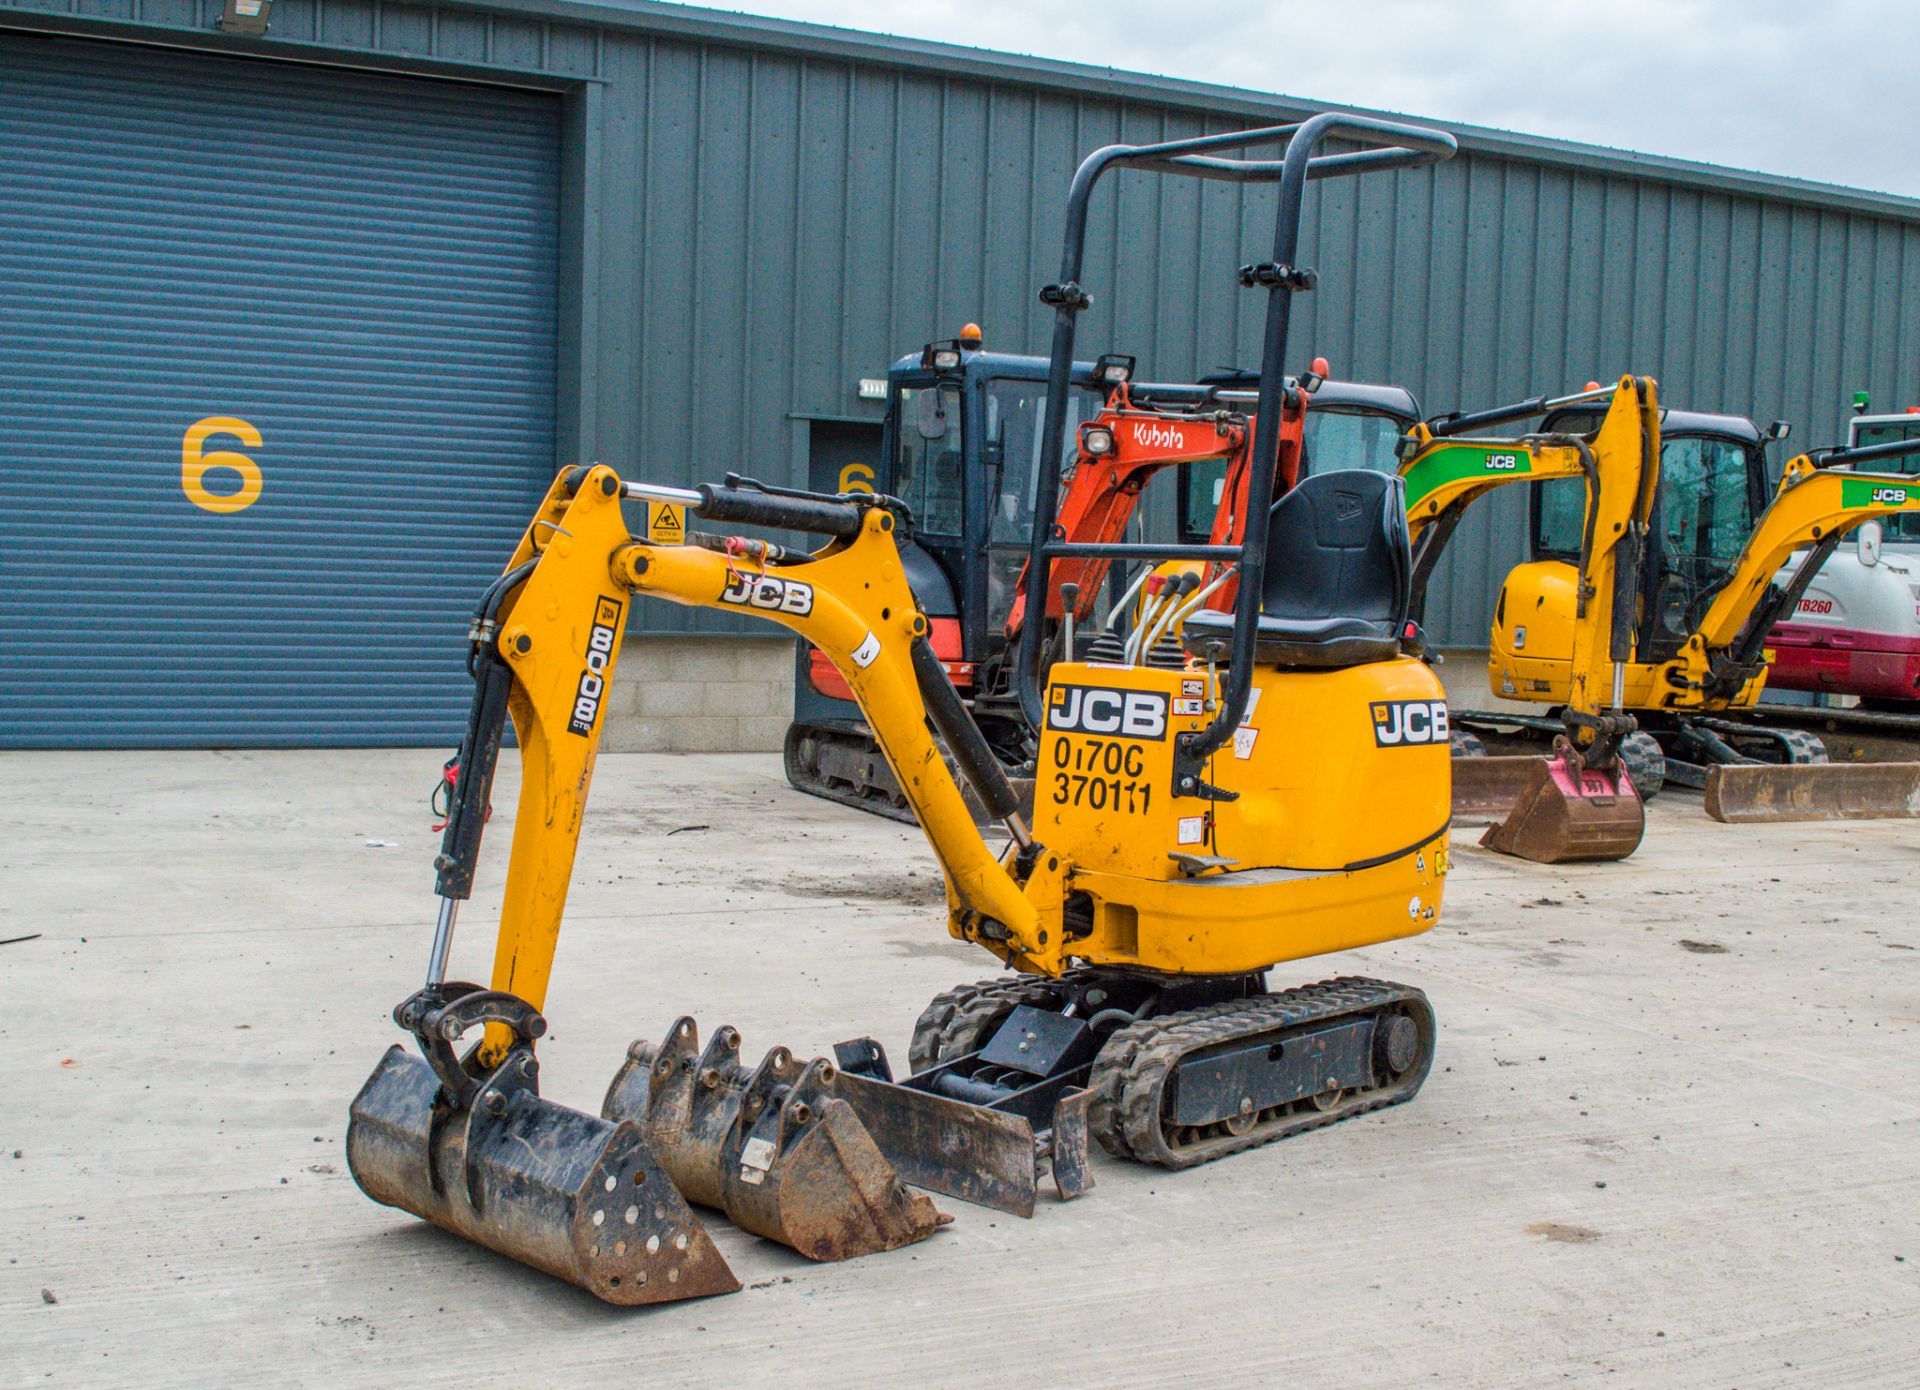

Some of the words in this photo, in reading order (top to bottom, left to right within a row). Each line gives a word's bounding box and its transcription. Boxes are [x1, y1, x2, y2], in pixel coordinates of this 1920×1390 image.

[1133, 422, 1183, 449] Kubota
[181, 416, 264, 513] 6
[1485, 455, 1516, 469] JCB
[1872, 488, 1906, 502] JCB
[723, 574, 813, 614] JCB
[1797, 599, 1833, 614] TB260
[574, 626, 614, 723] 8008
[1050, 688, 1166, 737] JCB
[1376, 702, 1449, 744] JCB
[1053, 772, 1151, 816] 370111
